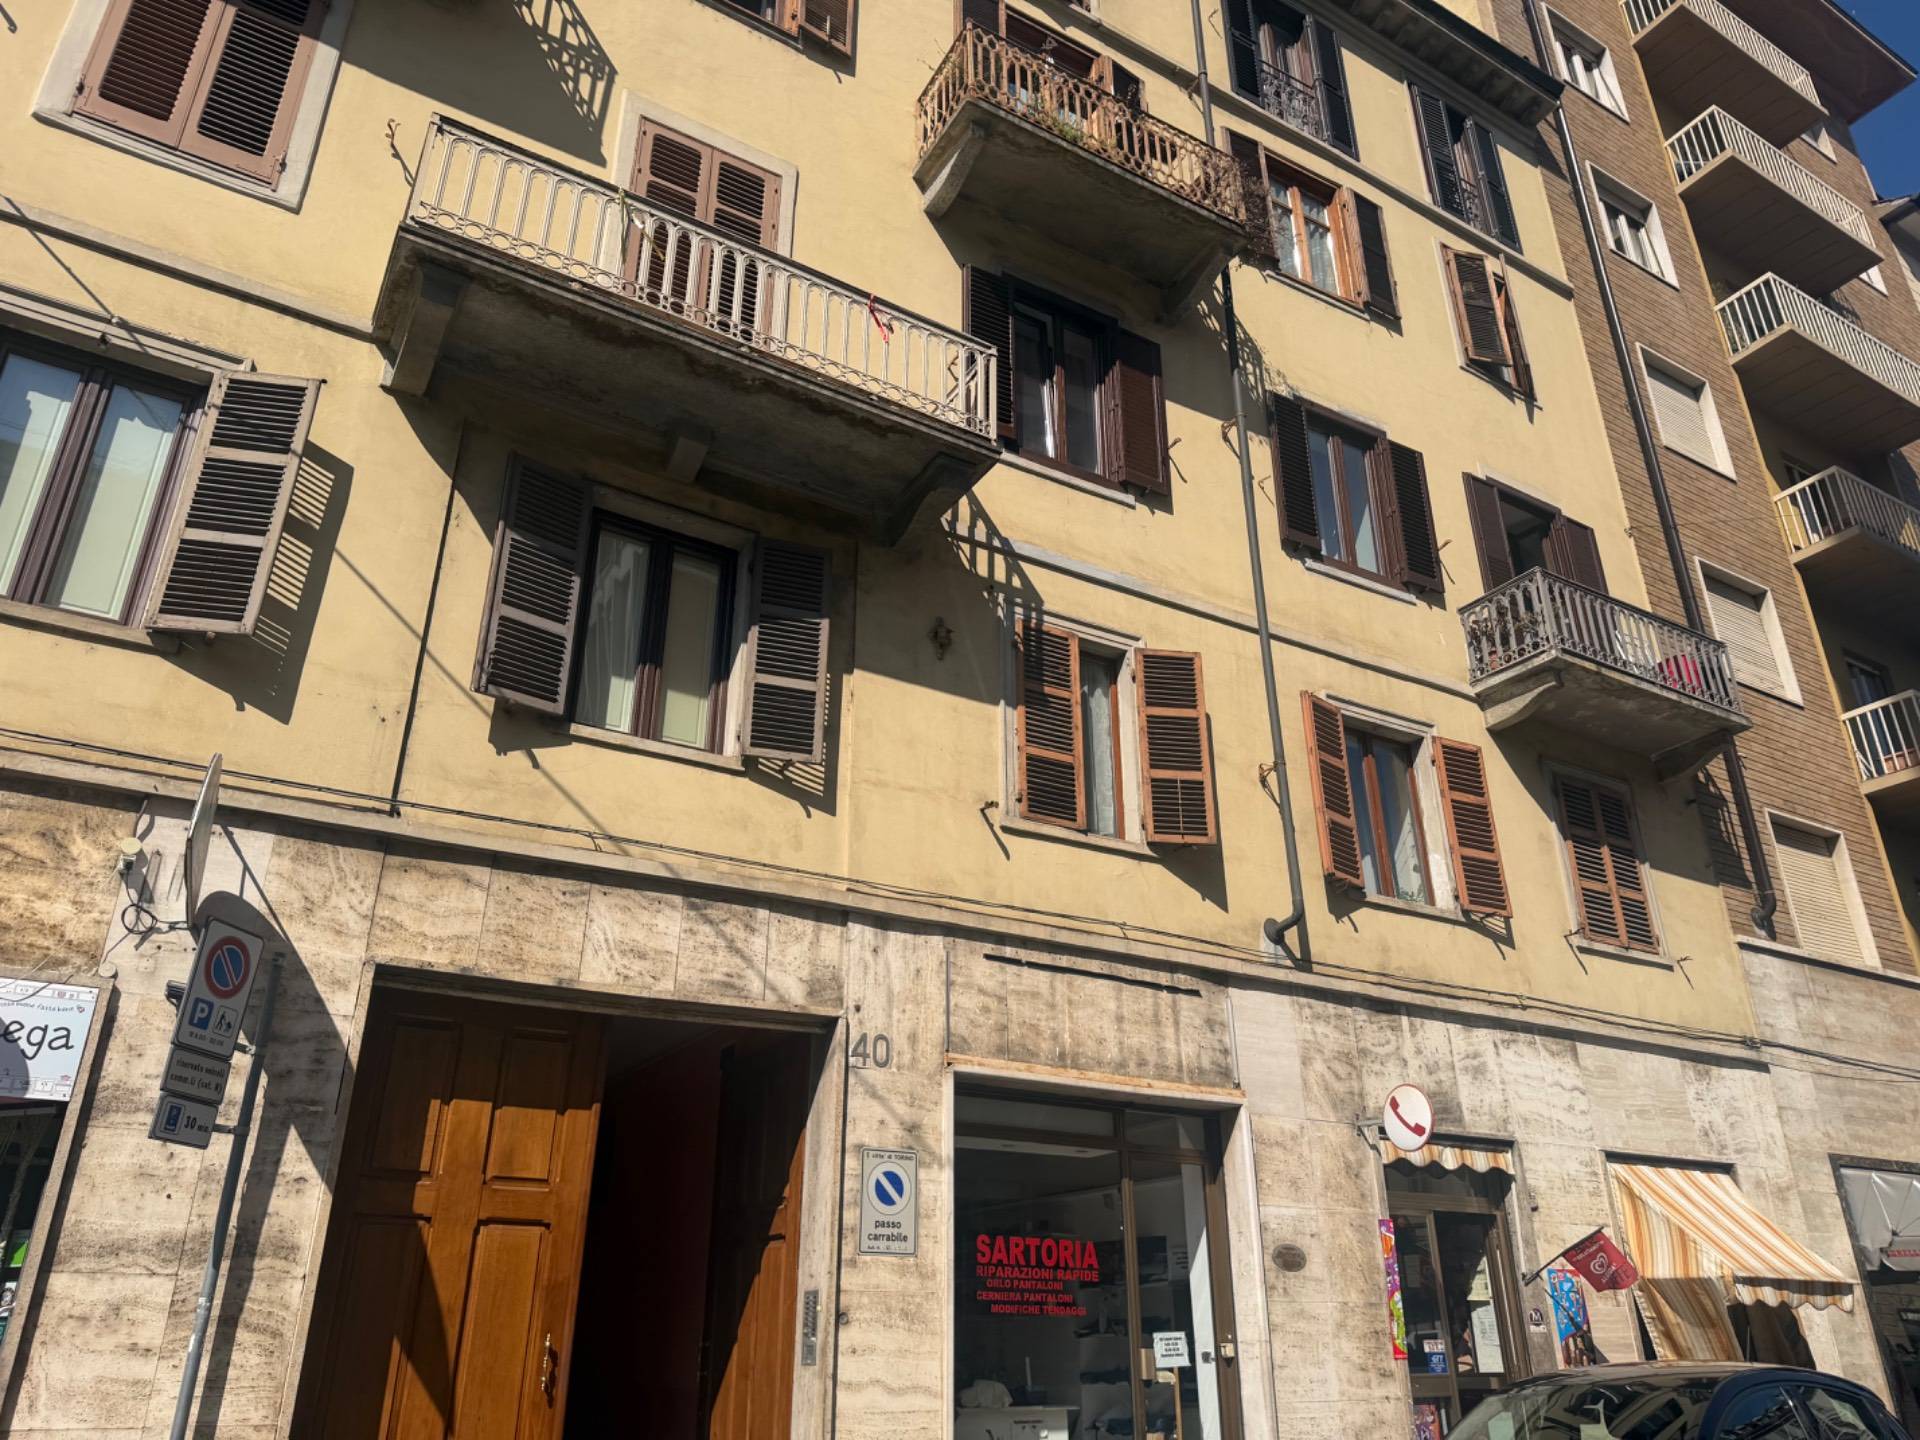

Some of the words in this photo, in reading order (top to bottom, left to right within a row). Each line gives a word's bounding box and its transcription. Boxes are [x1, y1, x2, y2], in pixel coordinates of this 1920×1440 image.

[193, 1000, 209, 1024] P
[851, 1032, 890, 1068] 40
[184, 1115, 197, 1129] 30
[875, 1220, 902, 1229] passo
[867, 1232, 908, 1242] carrabile
[976, 1234, 1099, 1268] SARTORIA
[976, 1265, 1053, 1280] RIPARAZIONI
[1057, 1269, 1100, 1282] RAPIDE
[986, 1279, 1011, 1288] ORLO
[1013, 1279, 1063, 1290] PANTALONI
[977, 1291, 1021, 1301] CERNIERA
[1024, 1292, 1073, 1303] PANTALONI
[991, 1304, 1040, 1314] MODIFICHE
